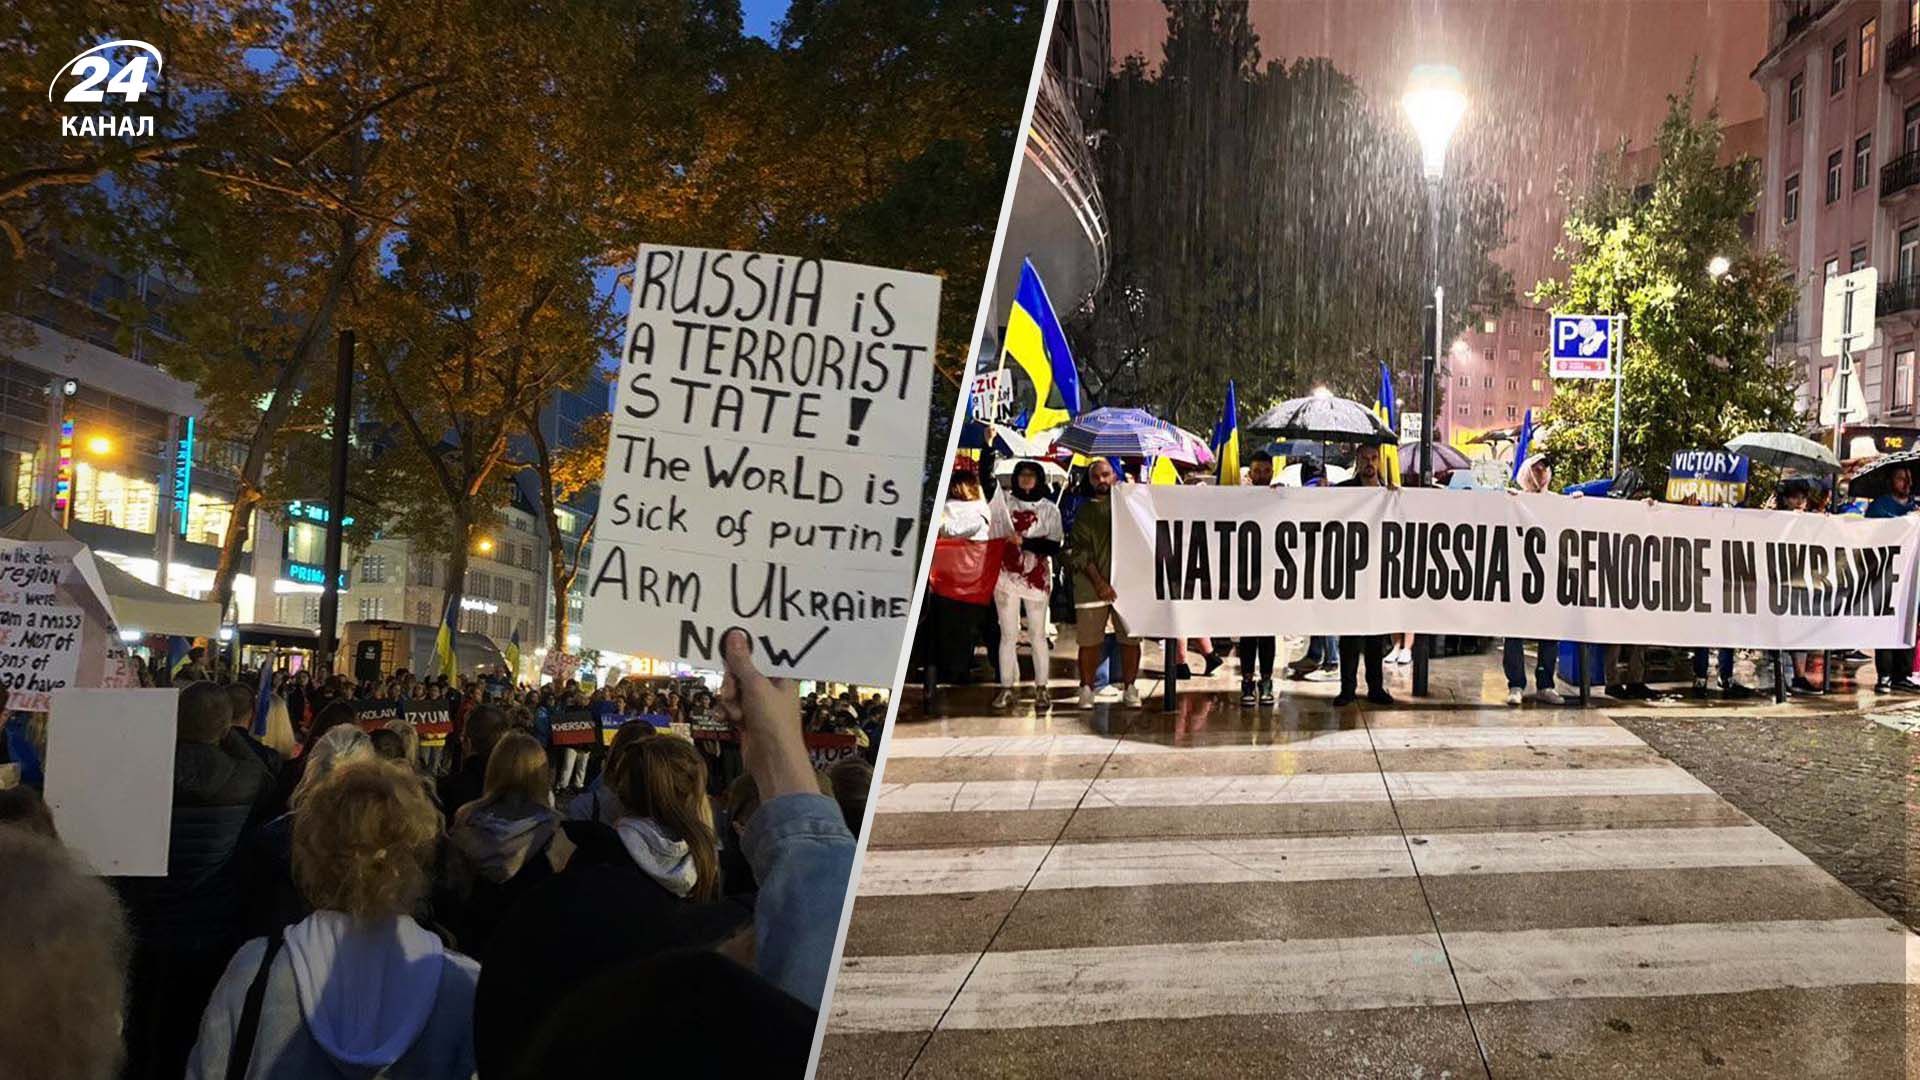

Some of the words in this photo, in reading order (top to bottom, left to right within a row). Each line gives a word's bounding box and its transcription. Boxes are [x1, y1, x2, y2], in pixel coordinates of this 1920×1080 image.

[1558, 320, 1579, 350] P
[629, 322, 655, 365] A
[672, 320, 927, 400] TERRORIST
[173, 439, 188, 511] PRIMARK
[616, 434, 691, 483] The
[865, 474, 900, 505] is
[1675, 451, 1740, 474] VICTORY
[1671, 482, 1738, 504] UKRAINE
[716, 509, 752, 547] of
[1155, 520, 1262, 601] NATO
[1274, 521, 1370, 601] STOP
[1556, 528, 1712, 613] GENOCIDE
[1722, 540, 1757, 615] IN
[1766, 541, 1902, 617] UKRAINE
[679, 619, 830, 669] NOW
[0, 652, 29, 669] gns
[32, 655, 51, 671] of
[356, 708, 397, 720] KOLAIV
[405, 711, 450, 725] IZYUM
